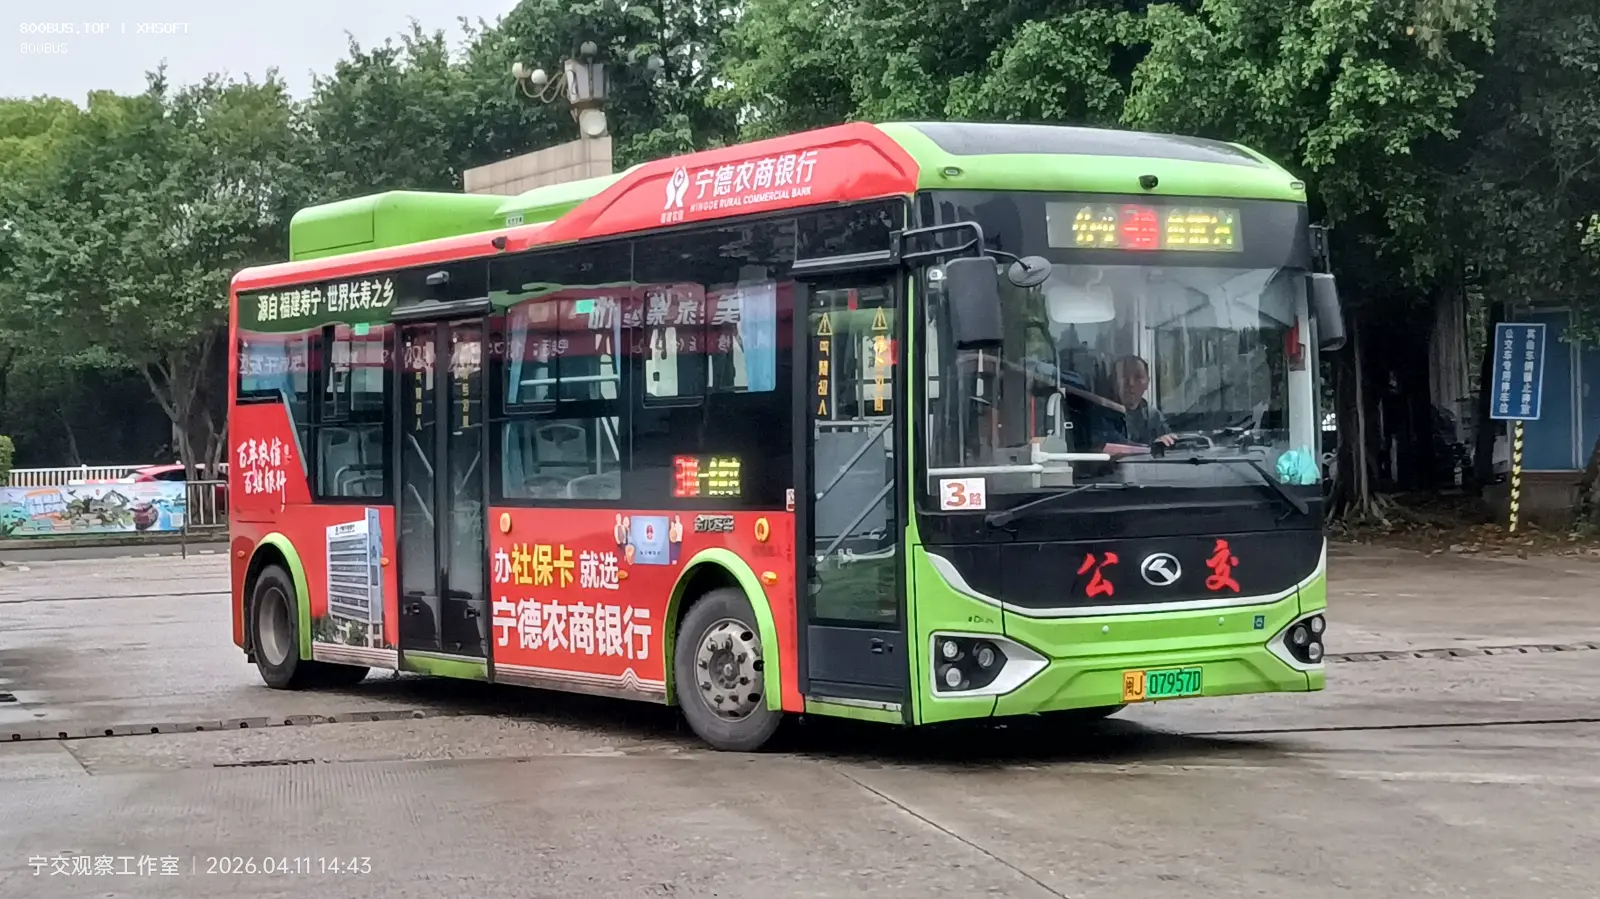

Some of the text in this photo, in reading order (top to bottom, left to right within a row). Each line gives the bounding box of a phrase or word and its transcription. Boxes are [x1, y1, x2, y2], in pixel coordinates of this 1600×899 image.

[695, 150, 818, 200] 宁德农商银行
[719, 196, 743, 209] RURAL
[791, 186, 812, 197] BANK
[945, 482, 982, 507] 3路
[1076, 538, 1240, 598] 公 交
[492, 596, 652, 660] 宁德农商银行
